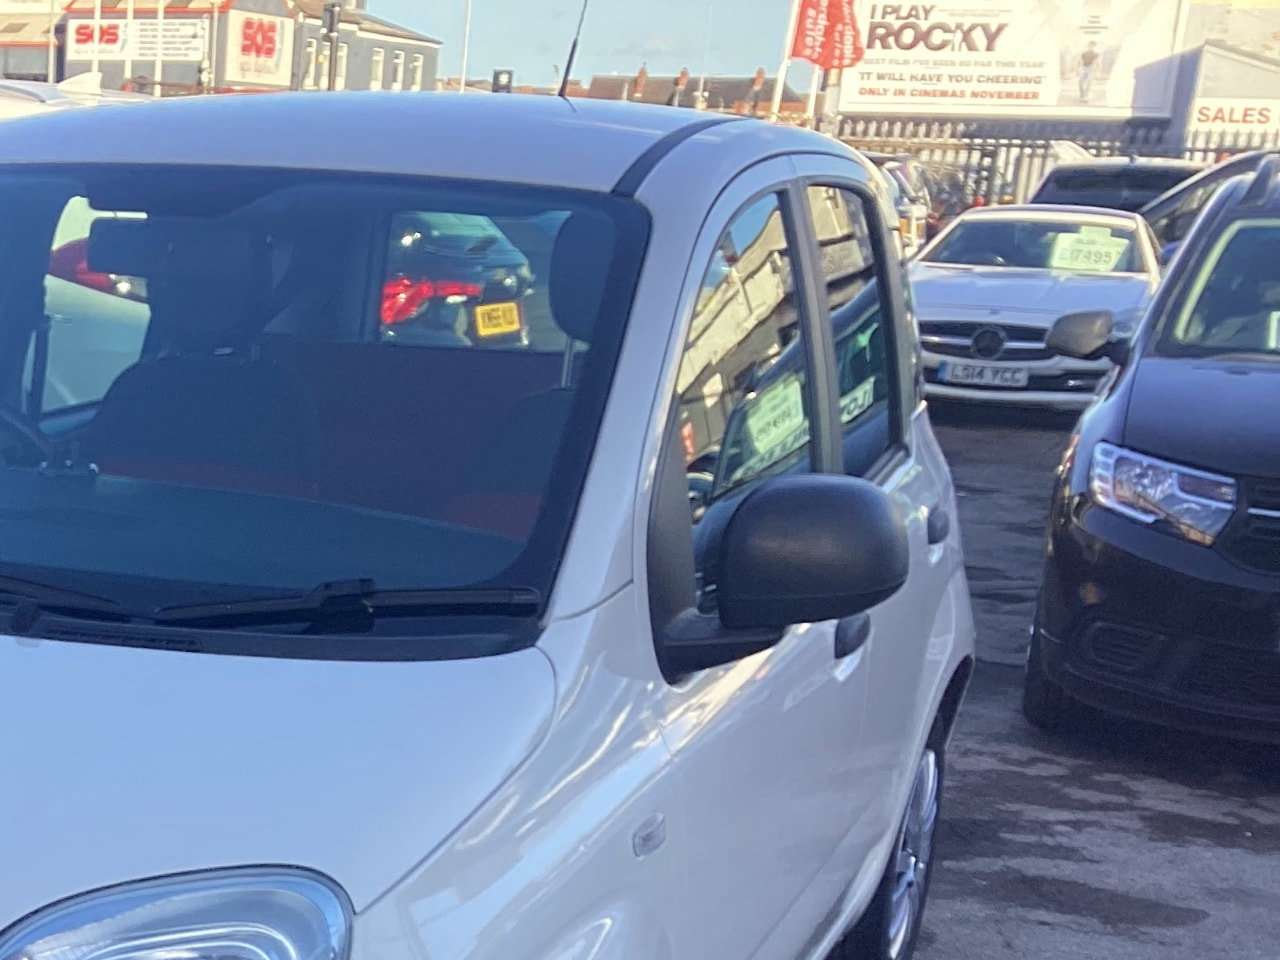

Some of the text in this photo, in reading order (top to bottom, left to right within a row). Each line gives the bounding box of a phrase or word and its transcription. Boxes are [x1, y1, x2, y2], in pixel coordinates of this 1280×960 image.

[870, 4, 877, 20] I
[881, 5, 936, 20] PLAY
[866, 21, 1008, 51] ROCKY
[876, 72, 905, 81] WILL
[909, 72, 943, 83] HAVE
[948, 74, 973, 83] YOU
[858, 87, 1040, 100] ONLY IN CINEMAS NOVEMBER
[1197, 106, 1271, 124] SALES
